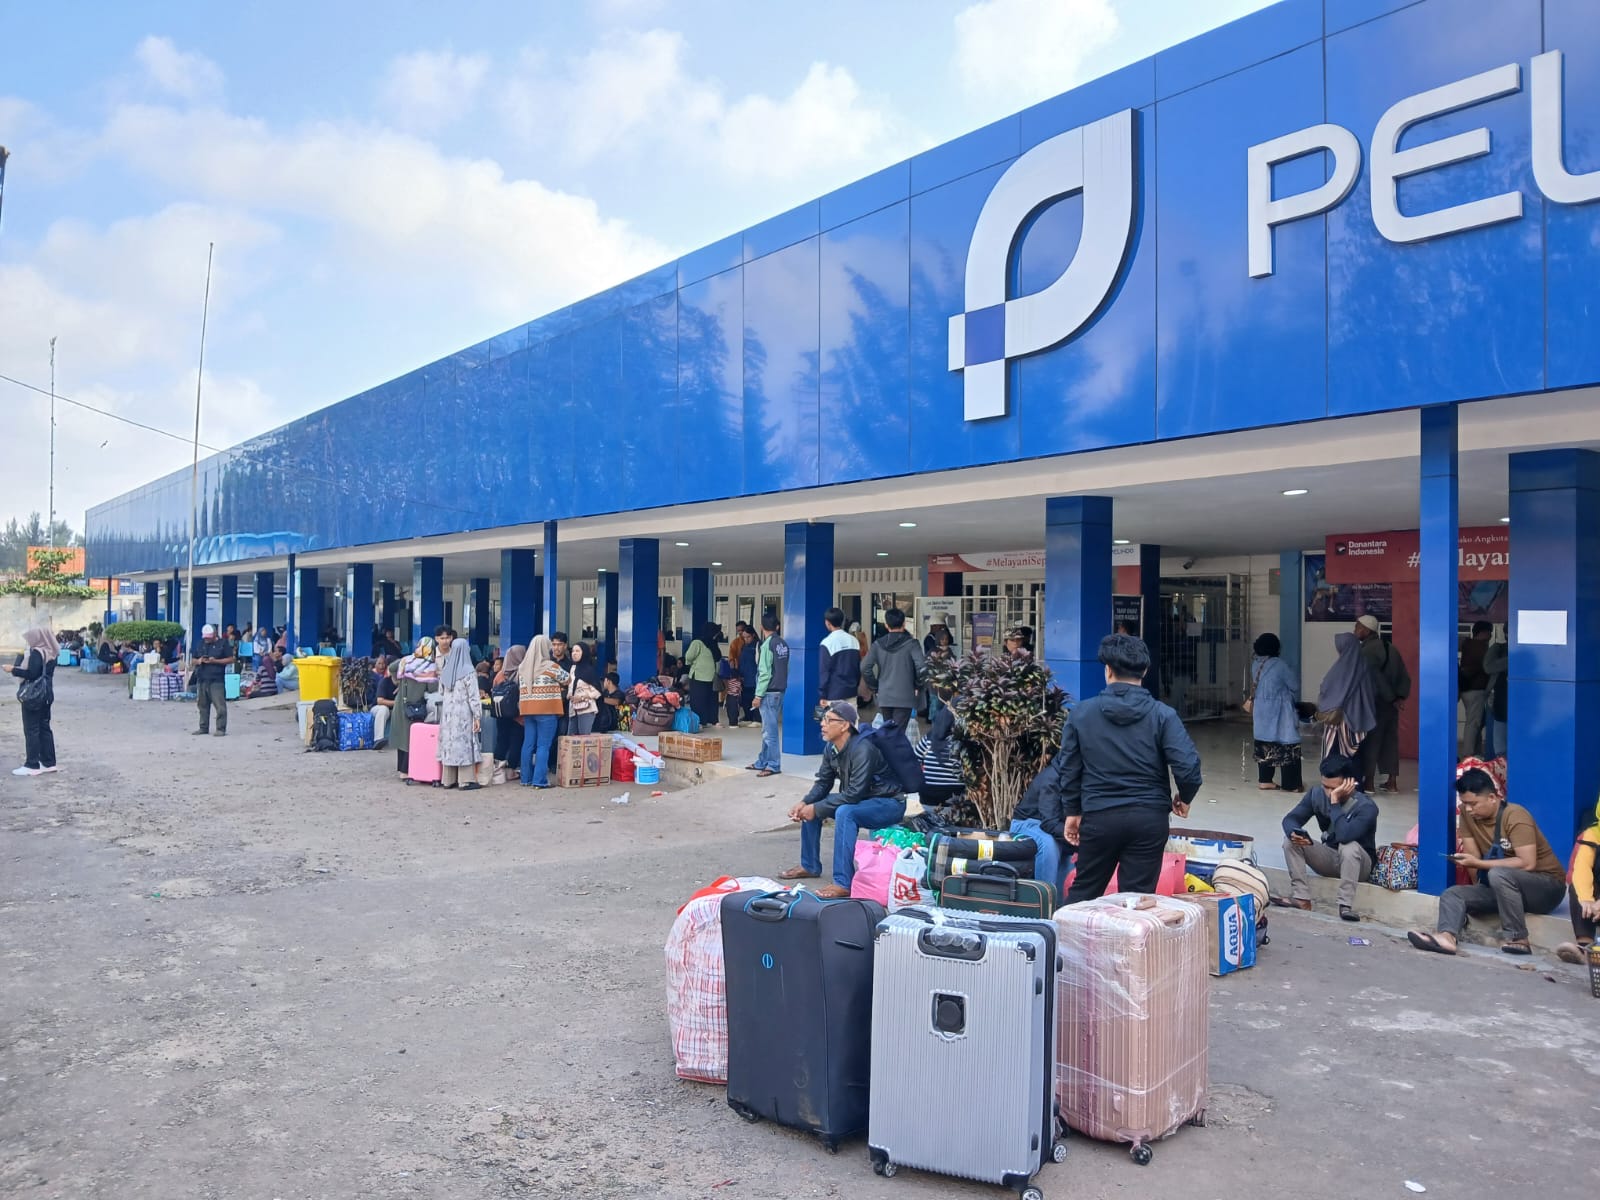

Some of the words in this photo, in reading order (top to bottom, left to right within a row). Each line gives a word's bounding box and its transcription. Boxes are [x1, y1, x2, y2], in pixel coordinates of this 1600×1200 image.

[1248, 49, 1600, 279] PEL
[1348, 540, 1387, 548] Danantara
[1348, 547, 1385, 556] Indonesia
[1228, 912, 1239, 956] AQUA
